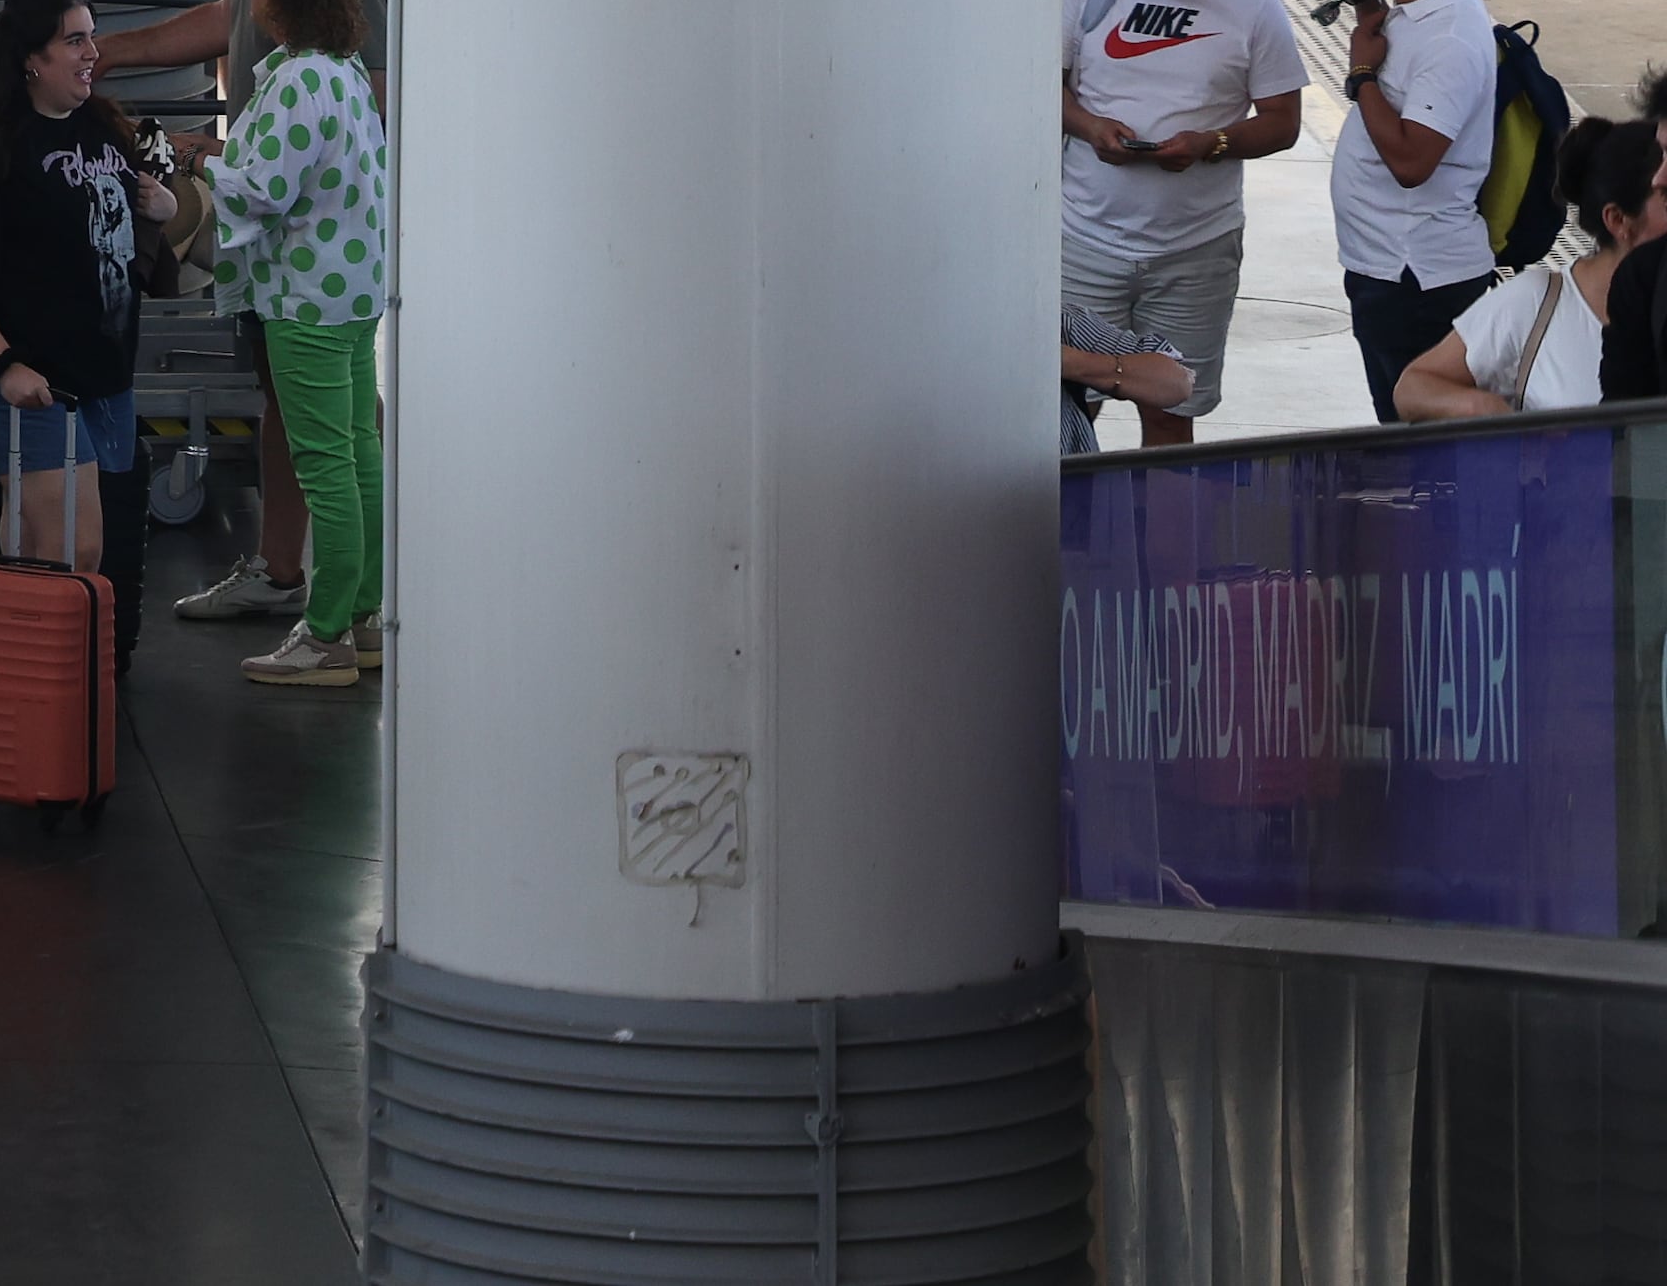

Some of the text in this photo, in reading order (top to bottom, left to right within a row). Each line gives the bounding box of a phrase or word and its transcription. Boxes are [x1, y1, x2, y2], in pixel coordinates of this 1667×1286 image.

[1122, 3, 1200, 39] NIKE
[1090, 589, 1109, 758] A
[1116, 586, 1244, 794] MADRID,
[1402, 522, 1521, 763] MADRÍ
